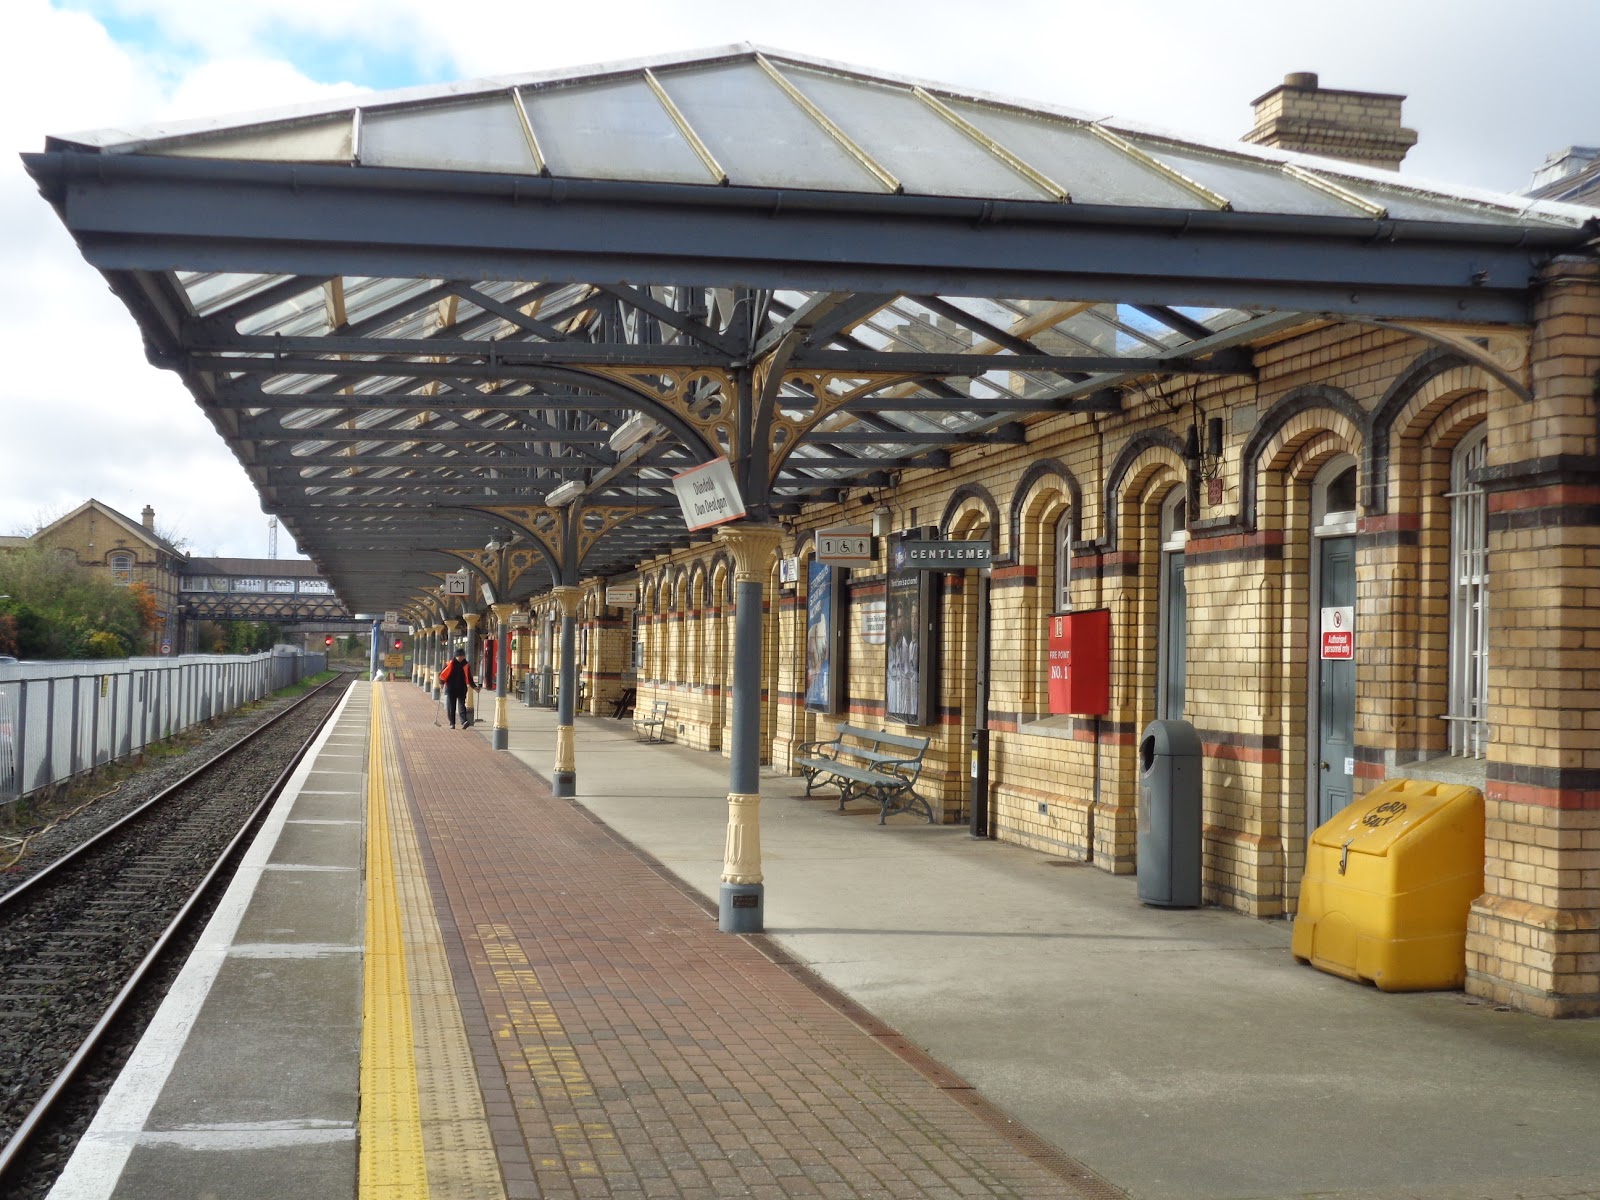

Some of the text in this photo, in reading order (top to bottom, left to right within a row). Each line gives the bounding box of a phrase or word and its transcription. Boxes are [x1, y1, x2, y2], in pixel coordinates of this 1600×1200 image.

[825, 541, 831, 552] 1
[910, 549, 991, 559] GENTLEMEN
[1049, 650, 1070, 659] FIRE POINT
[1362, 814, 1394, 828] SALT
